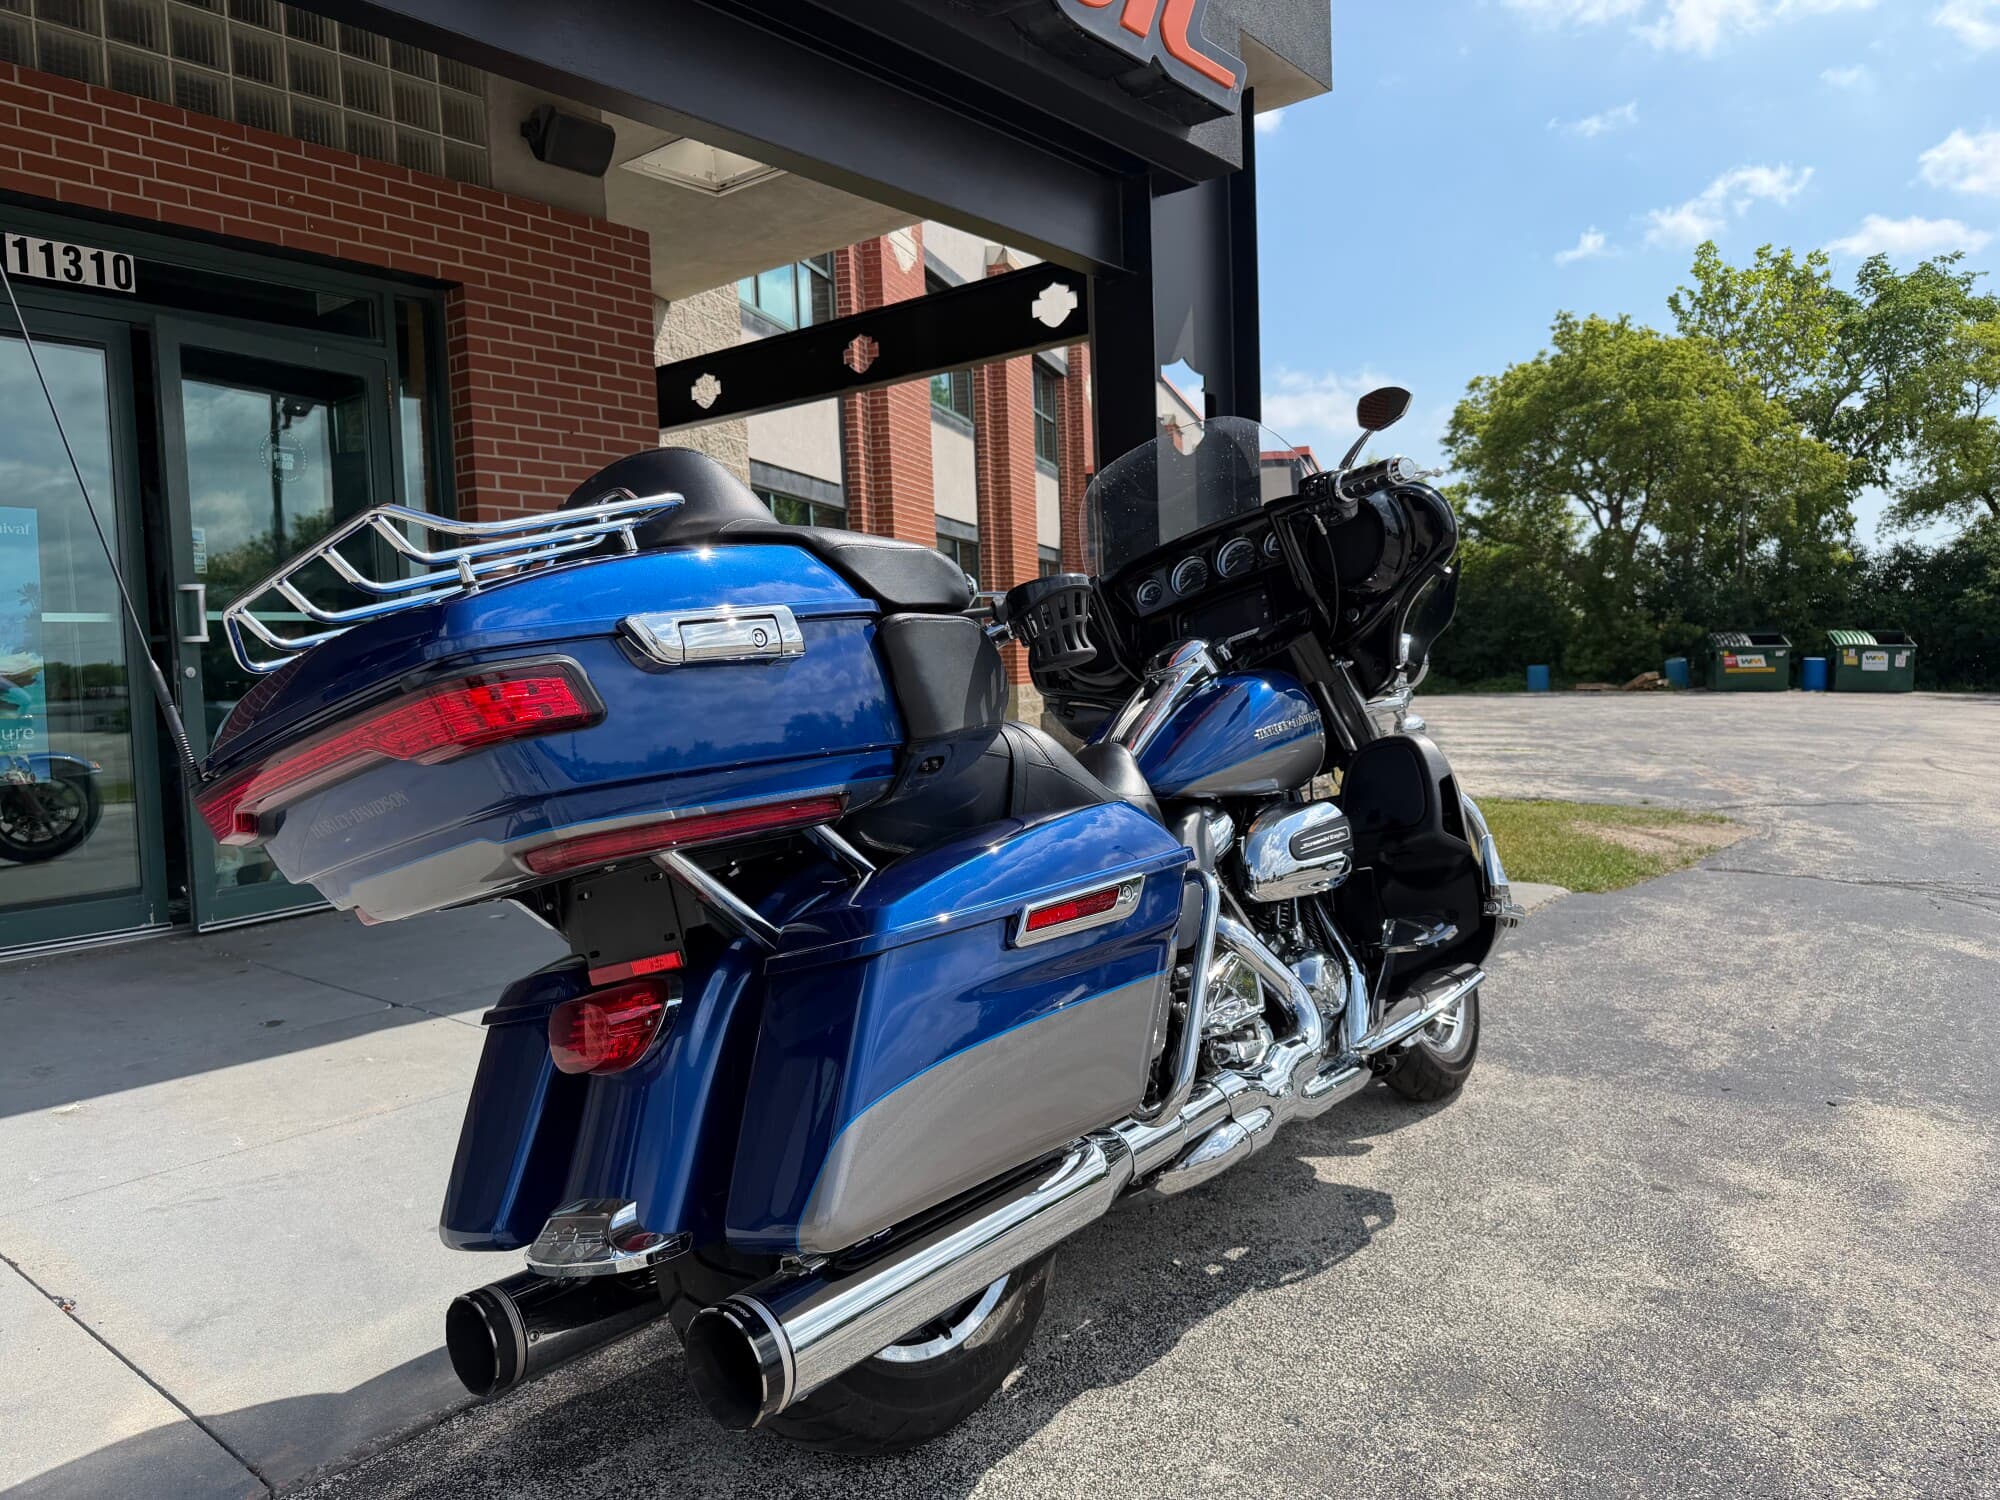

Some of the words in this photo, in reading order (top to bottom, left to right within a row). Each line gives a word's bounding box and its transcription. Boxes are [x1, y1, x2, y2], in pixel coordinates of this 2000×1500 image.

[12, 236, 133, 290] 11310
[1253, 708, 1321, 740] HARLEY-DAVIDS
[309, 789, 409, 840] HARLEY-DAVIDSON
